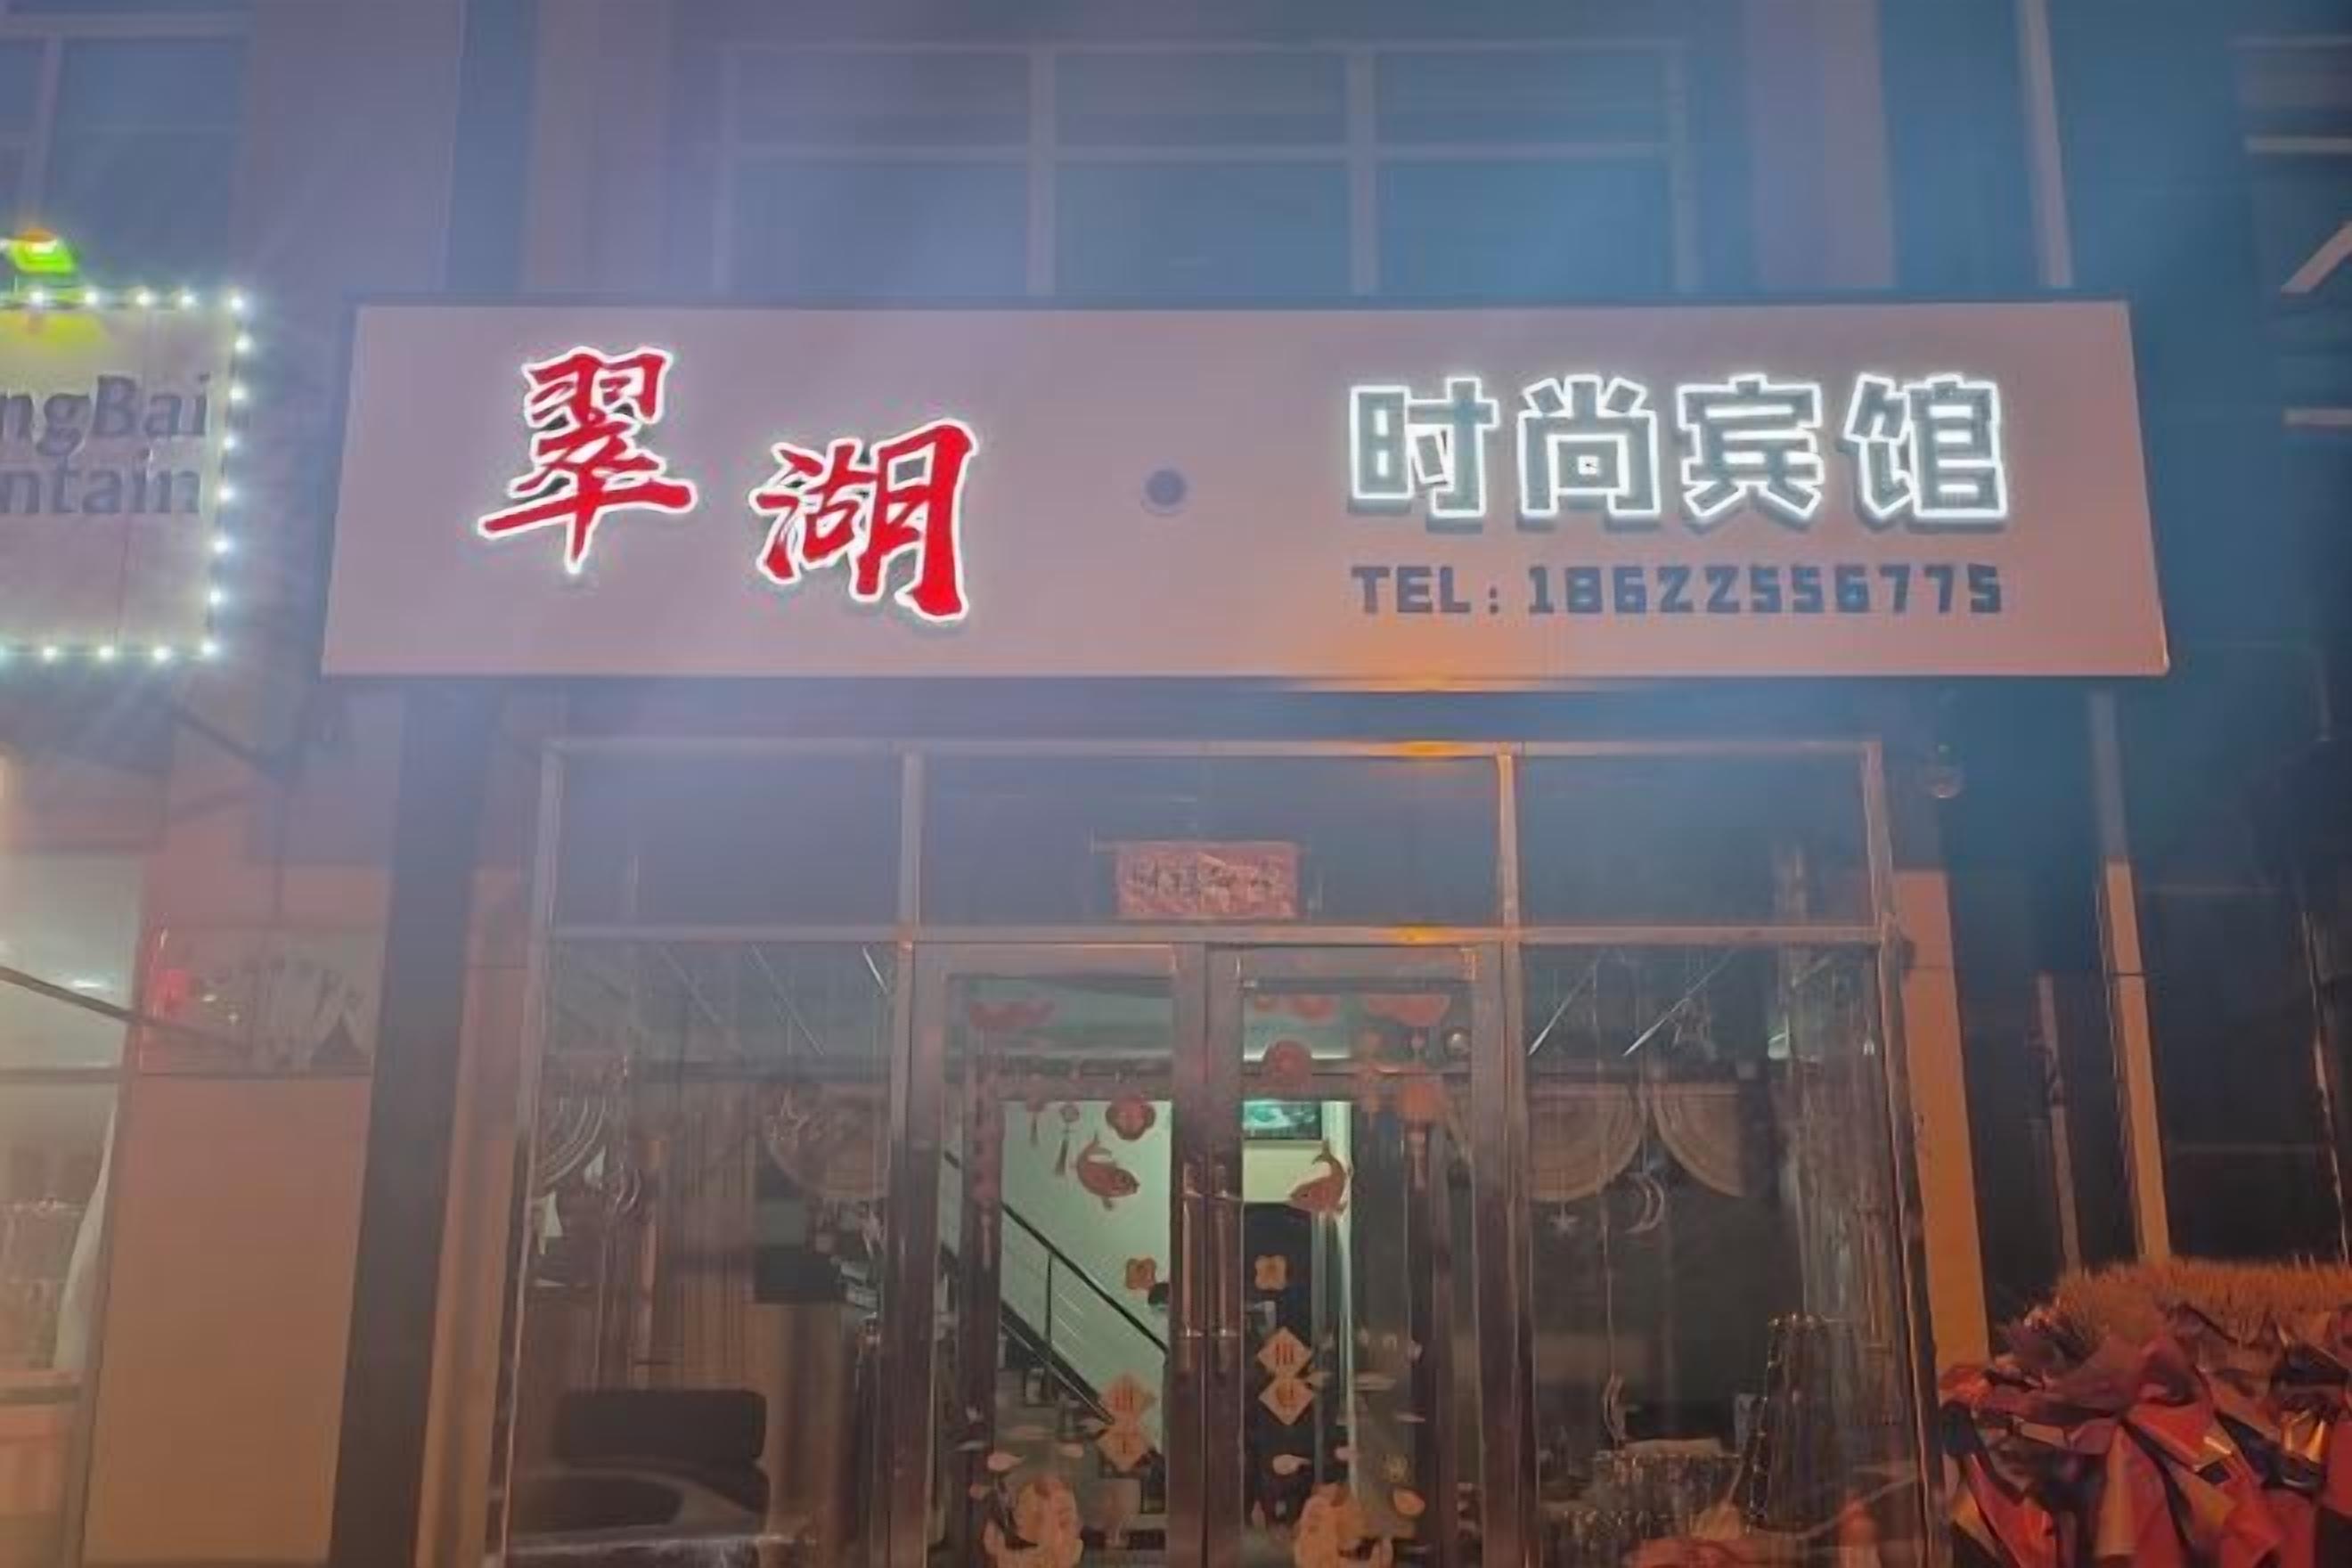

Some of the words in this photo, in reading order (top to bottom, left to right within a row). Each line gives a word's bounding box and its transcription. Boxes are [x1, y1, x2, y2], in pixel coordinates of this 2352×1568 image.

[478, 346, 980, 623] 翠湖
[1348, 374, 2009, 524] 时尚宾馆
